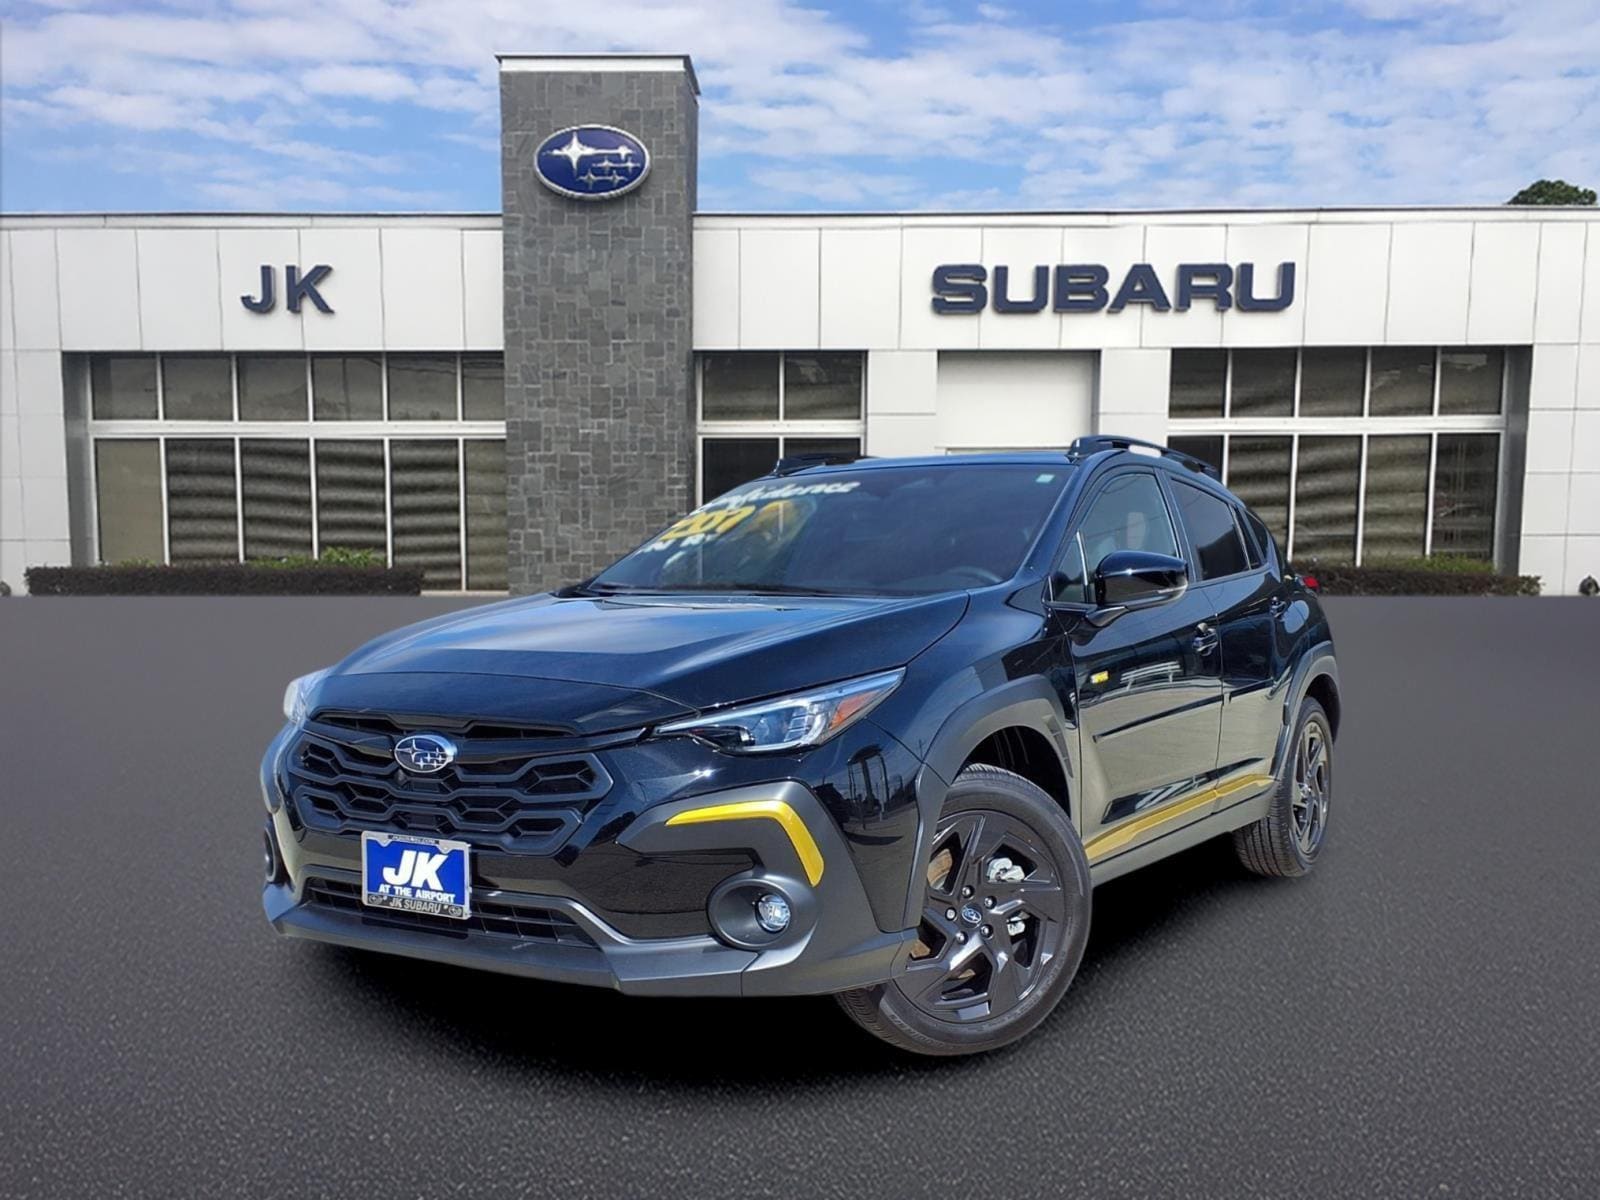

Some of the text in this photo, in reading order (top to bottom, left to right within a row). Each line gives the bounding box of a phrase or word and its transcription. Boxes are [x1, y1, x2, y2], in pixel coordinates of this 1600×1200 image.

[240, 264, 334, 315] JK
[931, 261, 1296, 315] SUBARU
[382, 850, 448, 891] JK
[378, 884, 456, 903] AT THE AIRPORT
[389, 897, 441, 914] JK SUBARU
